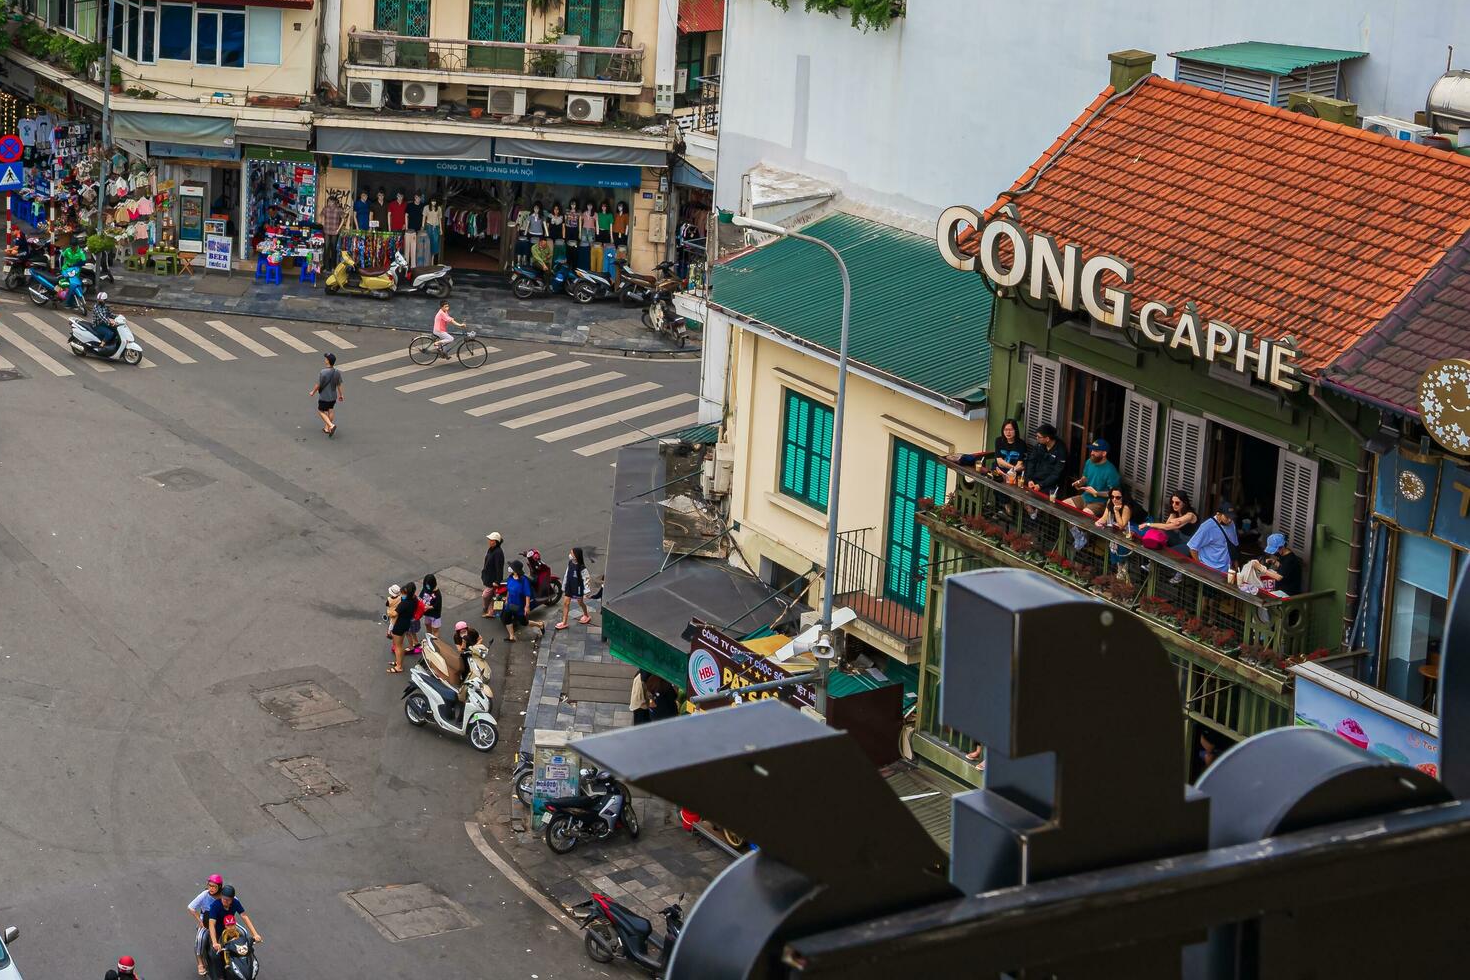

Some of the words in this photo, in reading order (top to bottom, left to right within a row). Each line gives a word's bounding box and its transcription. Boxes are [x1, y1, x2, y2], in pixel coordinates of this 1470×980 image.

[209, 252, 228, 262] BEER
[721, 639, 729, 650] TY
[698, 665, 715, 680] HBL
